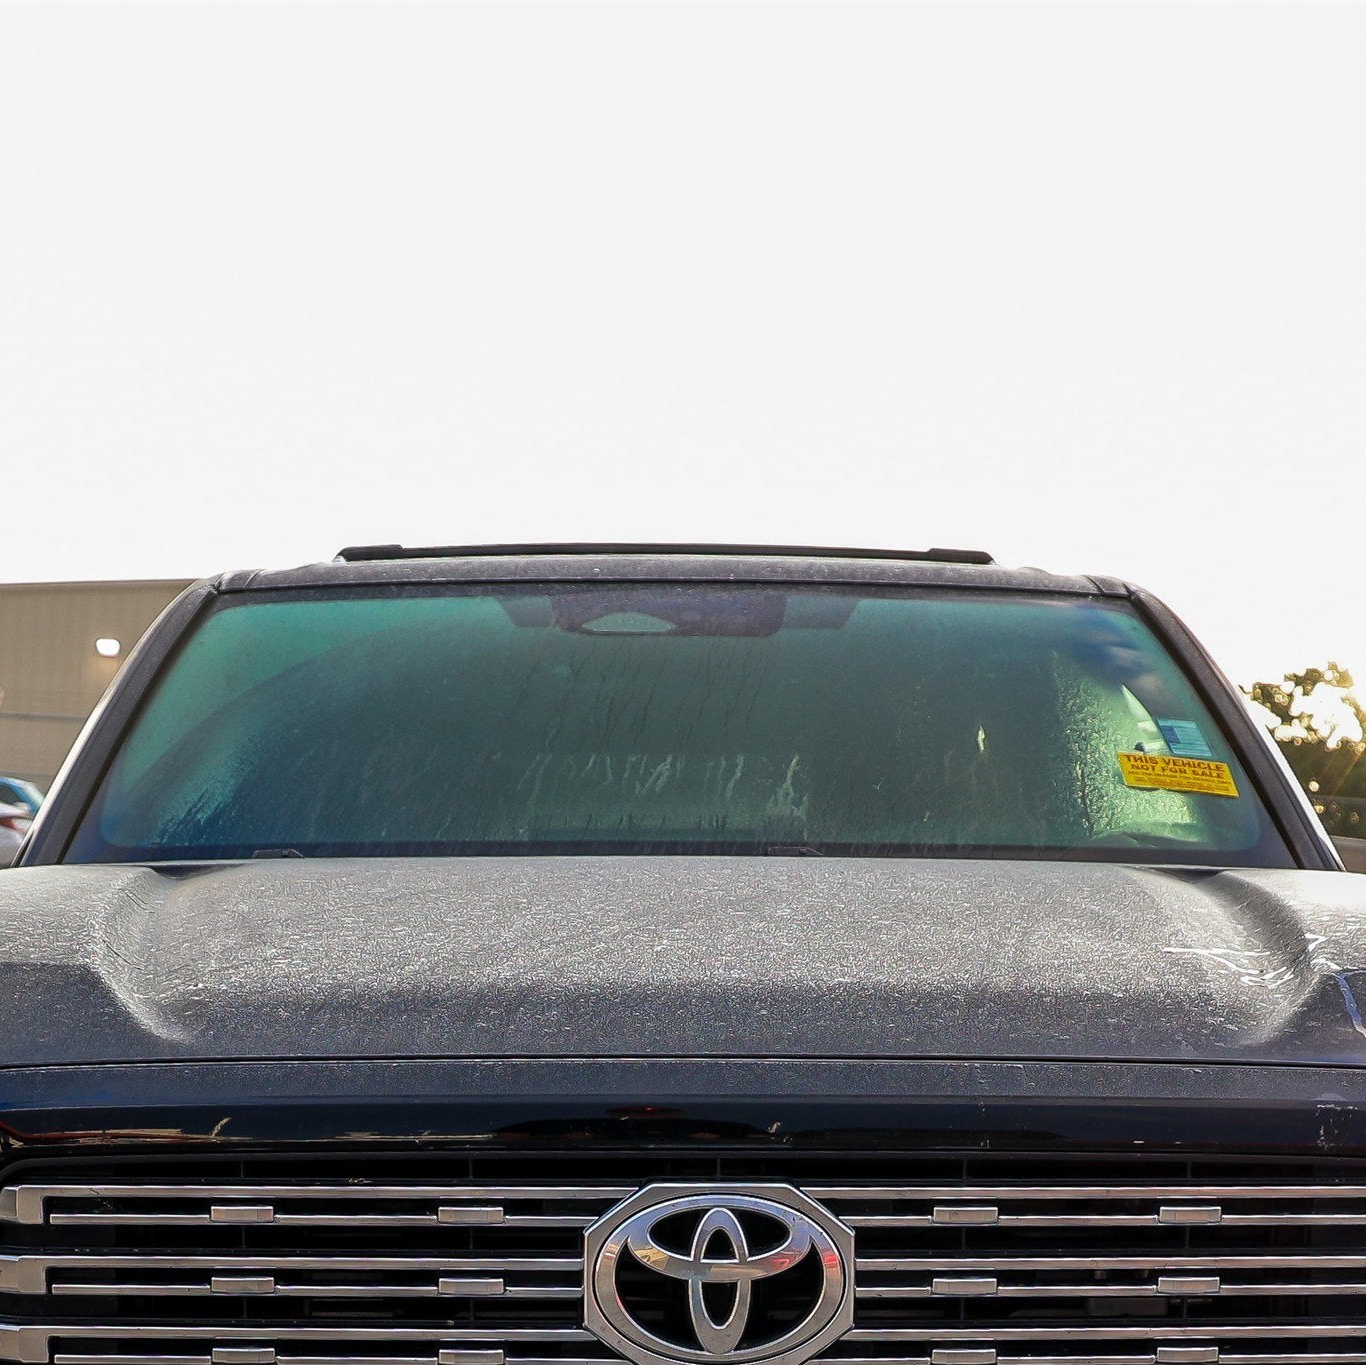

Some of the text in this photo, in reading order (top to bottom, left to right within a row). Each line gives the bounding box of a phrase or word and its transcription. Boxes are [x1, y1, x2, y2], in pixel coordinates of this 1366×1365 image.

[1124, 754, 1224, 772] THIS VEHICLE
[1130, 763, 1156, 772] NOT
[1161, 765, 1187, 775] FOR
[1190, 768, 1224, 779] SALE
